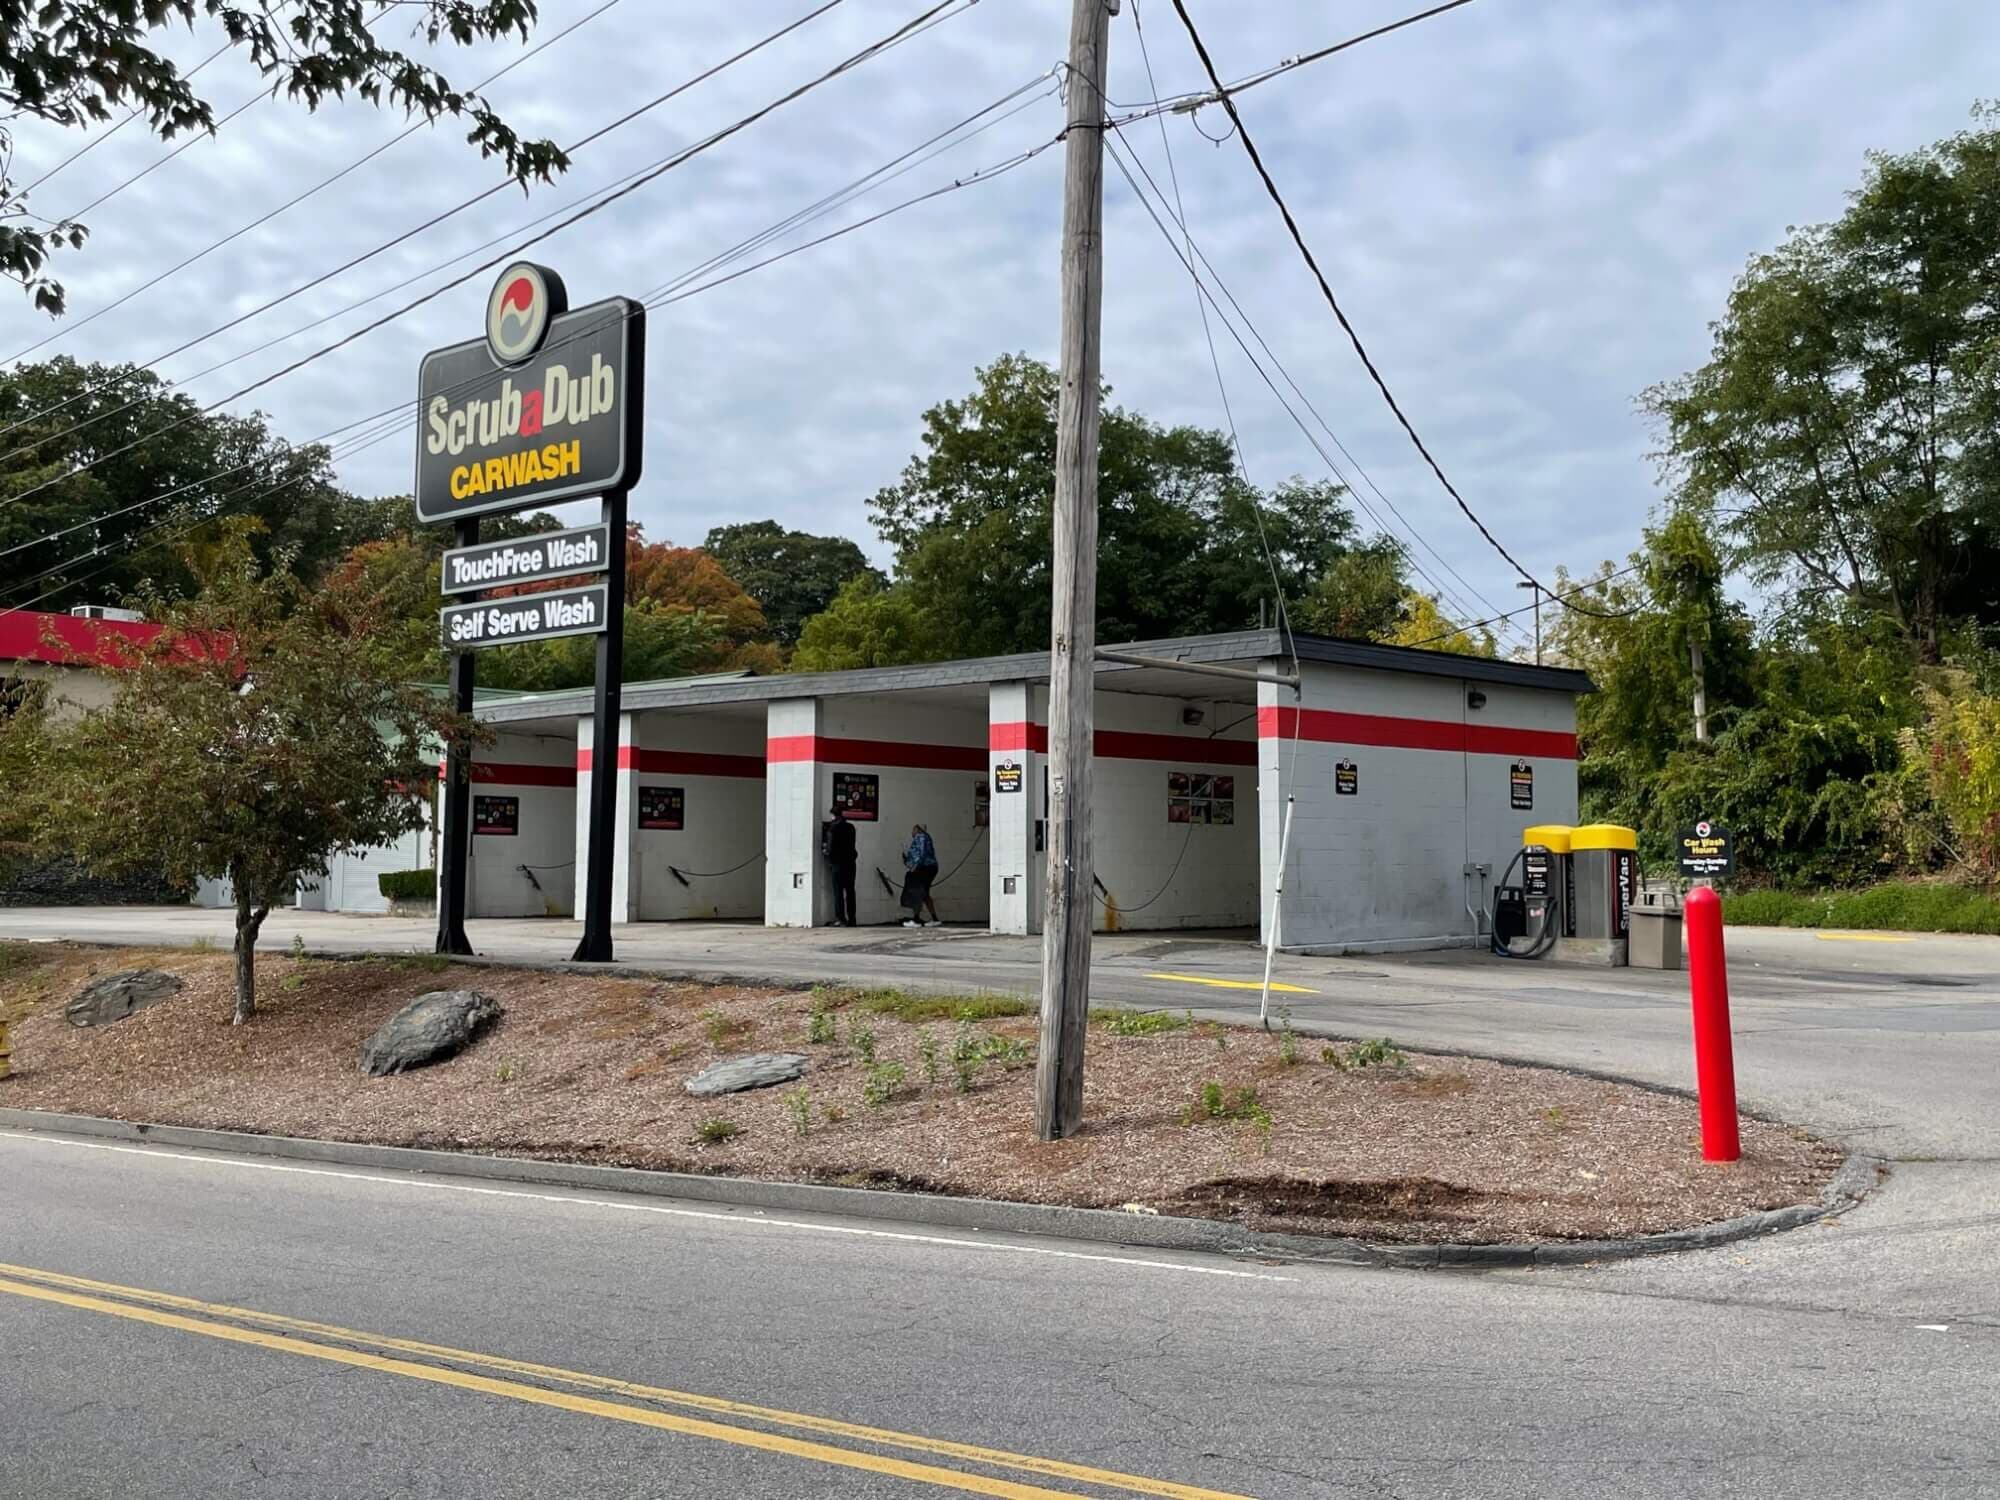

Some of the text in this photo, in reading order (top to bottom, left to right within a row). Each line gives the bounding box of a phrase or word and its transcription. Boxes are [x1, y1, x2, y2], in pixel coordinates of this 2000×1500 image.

[450, 440, 580, 499] CARWASH
[452, 535, 598, 583] TouchFree Wash
[450, 596, 595, 641] Self Serve Wash
[1683, 838, 1700, 847] Car
